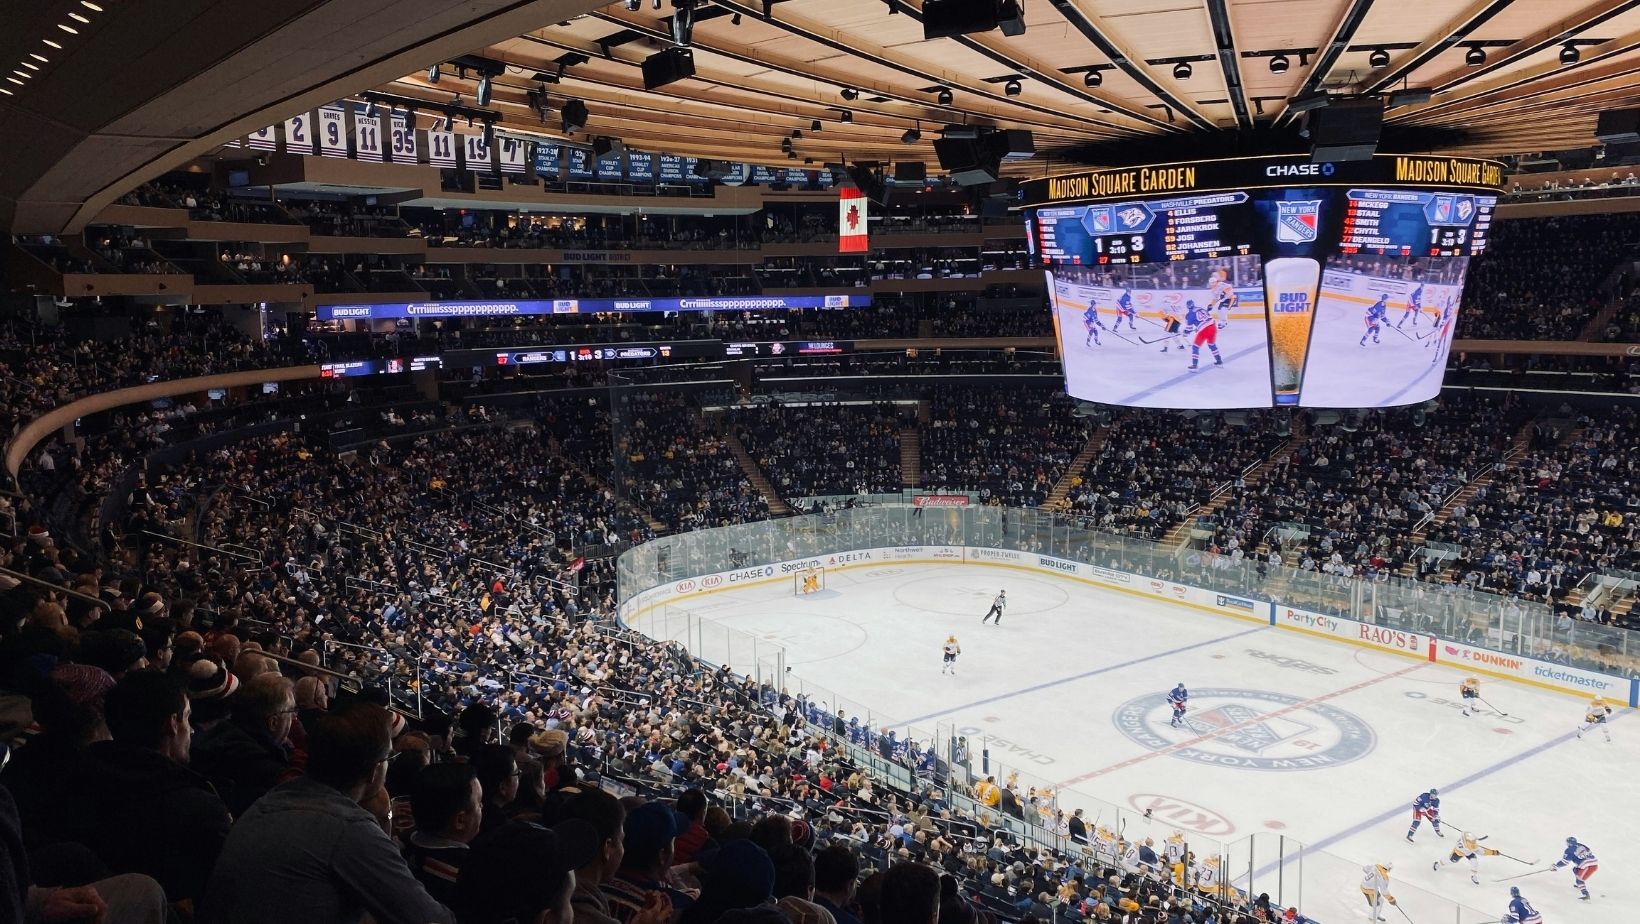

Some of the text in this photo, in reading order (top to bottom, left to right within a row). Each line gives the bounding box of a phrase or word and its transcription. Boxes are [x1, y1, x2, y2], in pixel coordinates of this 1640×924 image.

[292, 117, 304, 142] 2
[328, 122, 338, 145] 9
[361, 127, 377, 151] 11
[393, 130, 415, 153] 35
[434, 135, 450, 157] 11
[468, 138, 487, 160] 19
[1266, 164, 1320, 177] CHASE
[1396, 157, 1447, 181] MADISON
[1450, 159, 1481, 184] SQUARE
[1049, 167, 1196, 200] MADISON SQUARE GARDEN
[1161, 196, 1235, 209] NASHVILLE PREDATORS
[1174, 208, 1196, 216] ELLIS
[1175, 215, 1217, 225] FORSBERG
[1286, 216, 1314, 238] RANGERS
[1355, 218, 1379, 226] SMITH
[1131, 236, 1144, 251] 3
[1176, 234, 1194, 242] JOSI
[1431, 229, 1440, 244] 1
[1457, 229, 1466, 245] 3
[1095, 238, 1102, 252] 1
[1177, 240, 1220, 250] JOHANSEN
[1279, 293, 1308, 302] BUD
[1273, 302, 1312, 313] LIGHT
[570, 351, 576, 361] 1
[594, 350, 602, 360] 3
[917, 496, 965, 506] Budweiser
[838, 552, 871, 563] DELTA
[1040, 558, 1077, 572] BUD LIGHT
[781, 559, 819, 574] Spectrum
[704, 577, 719, 586] KIA
[729, 569, 764, 582] CHASE
[679, 582, 692, 591] KIA
[1360, 624, 1406, 648] RAO'S
[1473, 652, 1523, 670] DUNKIN'
[1534, 666, 1609, 691] ticketmaster
[977, 734, 1056, 765] CHASE
[1179, 749, 1335, 768] NEW YORK
[1147, 798, 1222, 831] KIA
